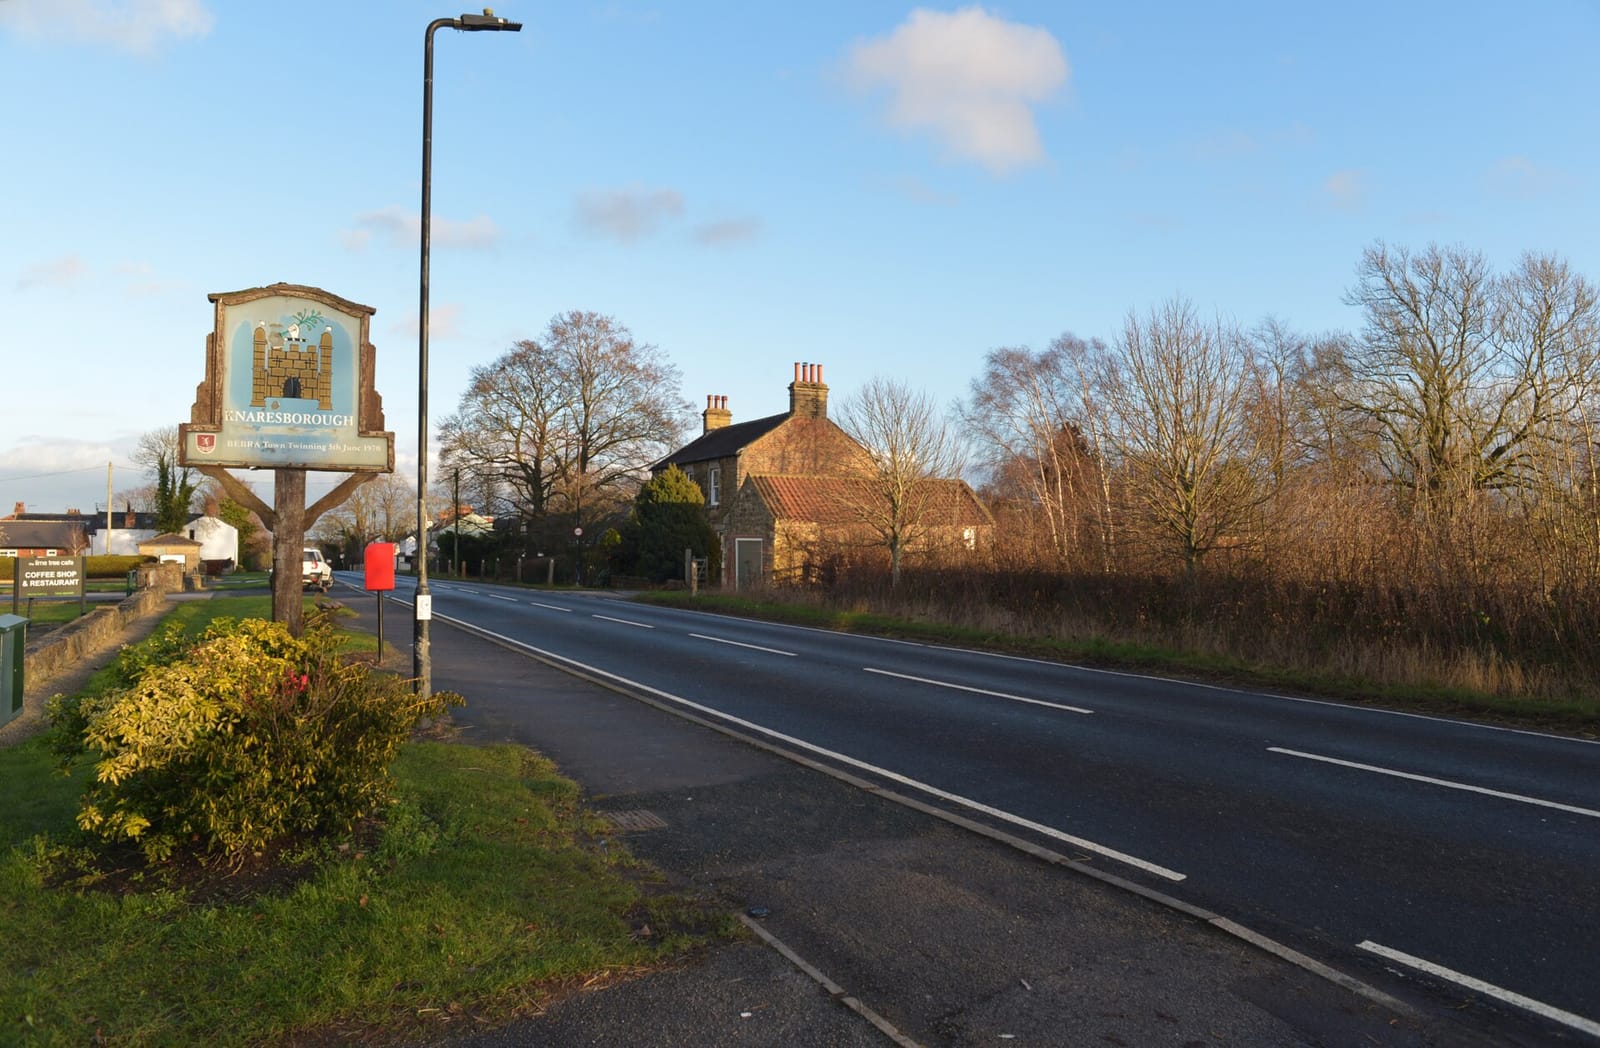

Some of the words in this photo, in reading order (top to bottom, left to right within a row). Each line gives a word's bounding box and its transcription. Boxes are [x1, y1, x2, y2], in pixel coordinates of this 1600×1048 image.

[224, 410, 354, 427] KNARESBOROUGH
[262, 440, 285, 449] Town
[287, 441, 327, 452] Twinning
[341, 443, 361, 452] June
[24, 571, 56, 579] COFFEE
[56, 570, 77, 578] SHOP
[29, 579, 80, 587] RESTAURANT
